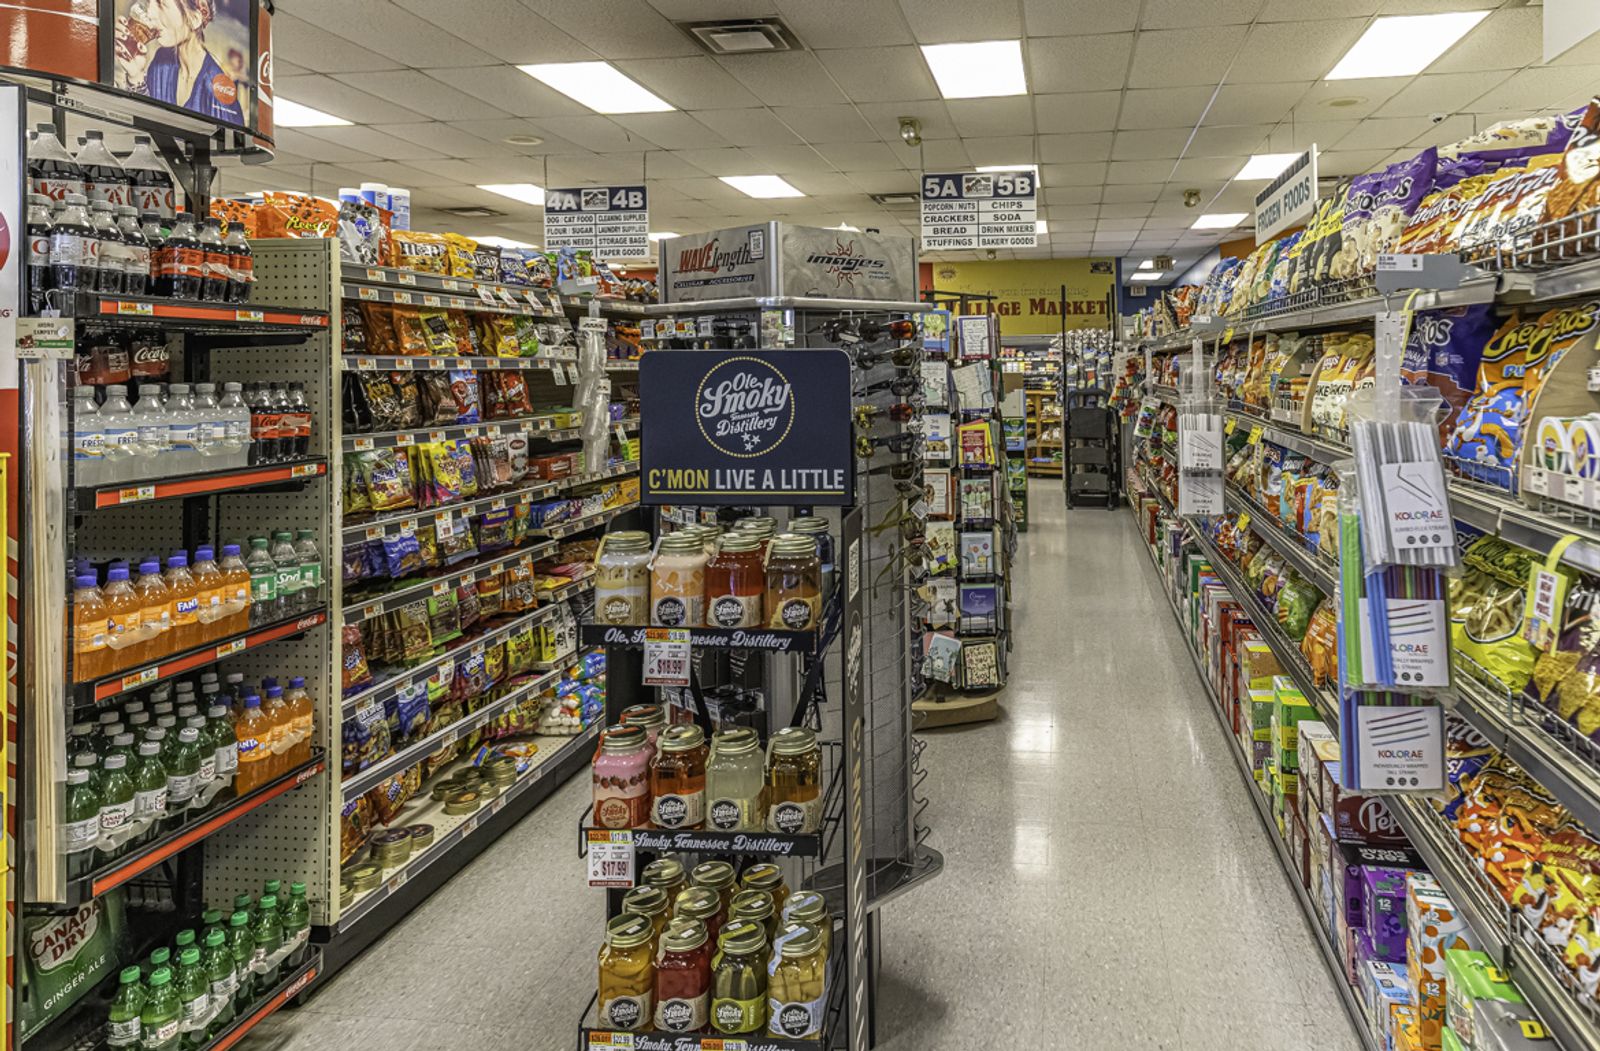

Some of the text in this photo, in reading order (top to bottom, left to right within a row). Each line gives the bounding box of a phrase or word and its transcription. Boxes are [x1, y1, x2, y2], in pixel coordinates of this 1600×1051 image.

[925, 177, 958, 198] 5A
[997, 175, 1031, 196] 5B
[546, 191, 578, 211] 4A
[612, 189, 644, 209] 4B
[991, 201, 1023, 209] CHIPS
[1257, 176, 1310, 234] FROZEN FOODS
[924, 203, 954, 211] POPCORN
[958, 202, 976, 210] NUTS
[546, 216, 560, 224] DOG
[563, 215, 575, 223] CAT
[577, 214, 594, 223] FOOD
[623, 213, 646, 221] SUPPLIES
[924, 214, 976, 223] CRACKERS
[993, 213, 1021, 221] SODA
[546, 226, 594, 235] FLOUR SUGAR
[933, 226, 967, 235] BREAD
[981, 224, 1034, 233] DRINK MIXERS
[547, 238, 594, 246] BAKING NEEDS
[598, 236, 646, 245] STORAGE BAGS
[926, 238, 973, 247] STUFFINGS
[981, 236, 1034, 246] BAKERY GOODS
[622, 248, 645, 256] GOODS
[807, 253, 885, 270] images
[1029, 297, 1108, 316] MARKET
[732, 372, 763, 391] Ole
[700, 378, 790, 418] Smoky
[716, 416, 777, 436] Distillery
[649, 468, 844, 490] C'MON LIVE A LITTLE
[1394, 509, 1443, 521] KOLORAE
[731, 630, 792, 650] Distillery
[1378, 750, 1424, 758] KOLORAE
[674, 833, 729, 849] Tennessee
[732, 834, 794, 853] Distillery
[602, 861, 626, 876] $17.99
[1378, 898, 1391, 906] 12
[51, 923, 88, 962] DRY
[43, 954, 106, 1011] GINGER ALE
